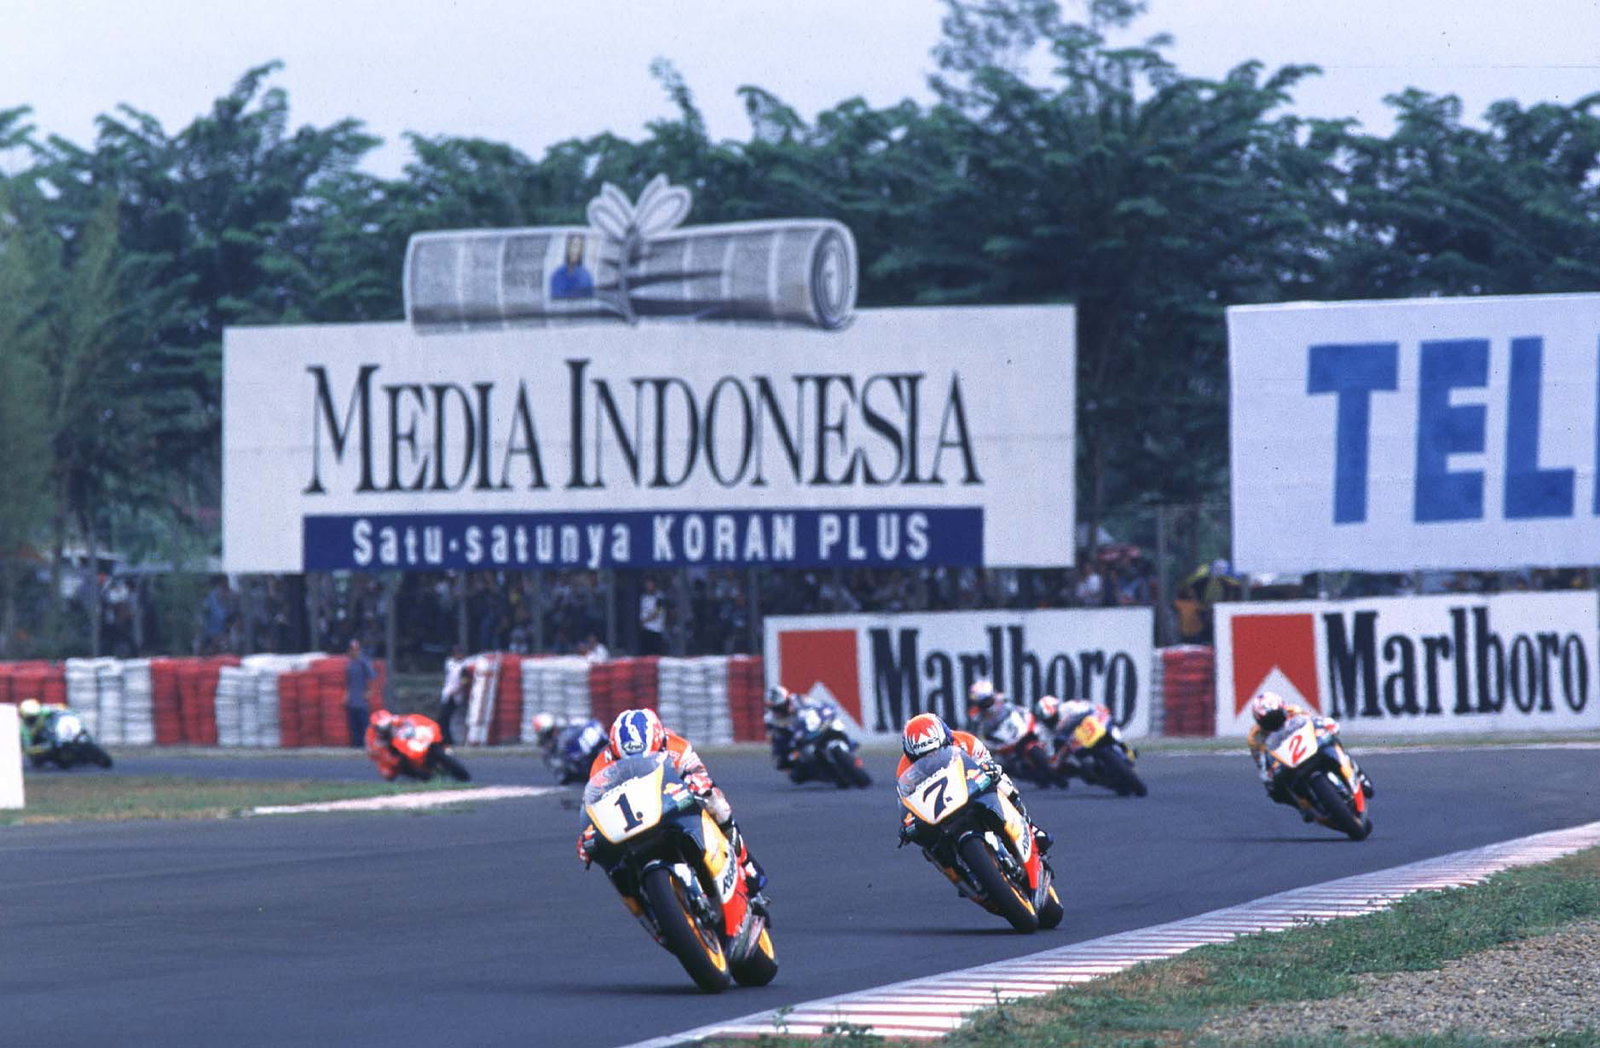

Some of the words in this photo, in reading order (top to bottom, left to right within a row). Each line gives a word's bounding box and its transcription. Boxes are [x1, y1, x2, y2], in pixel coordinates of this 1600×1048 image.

[302, 364, 547, 495] MEDIA
[566, 359, 984, 489] INDONESIA
[1306, 336, 1600, 525] TEL
[653, 514, 795, 562] KORAN
[819, 513, 931, 561] PLUS
[868, 625, 1139, 733] Marlboro
[1323, 606, 1588, 719] Marlboro
[1288, 734, 1307, 764] 2
